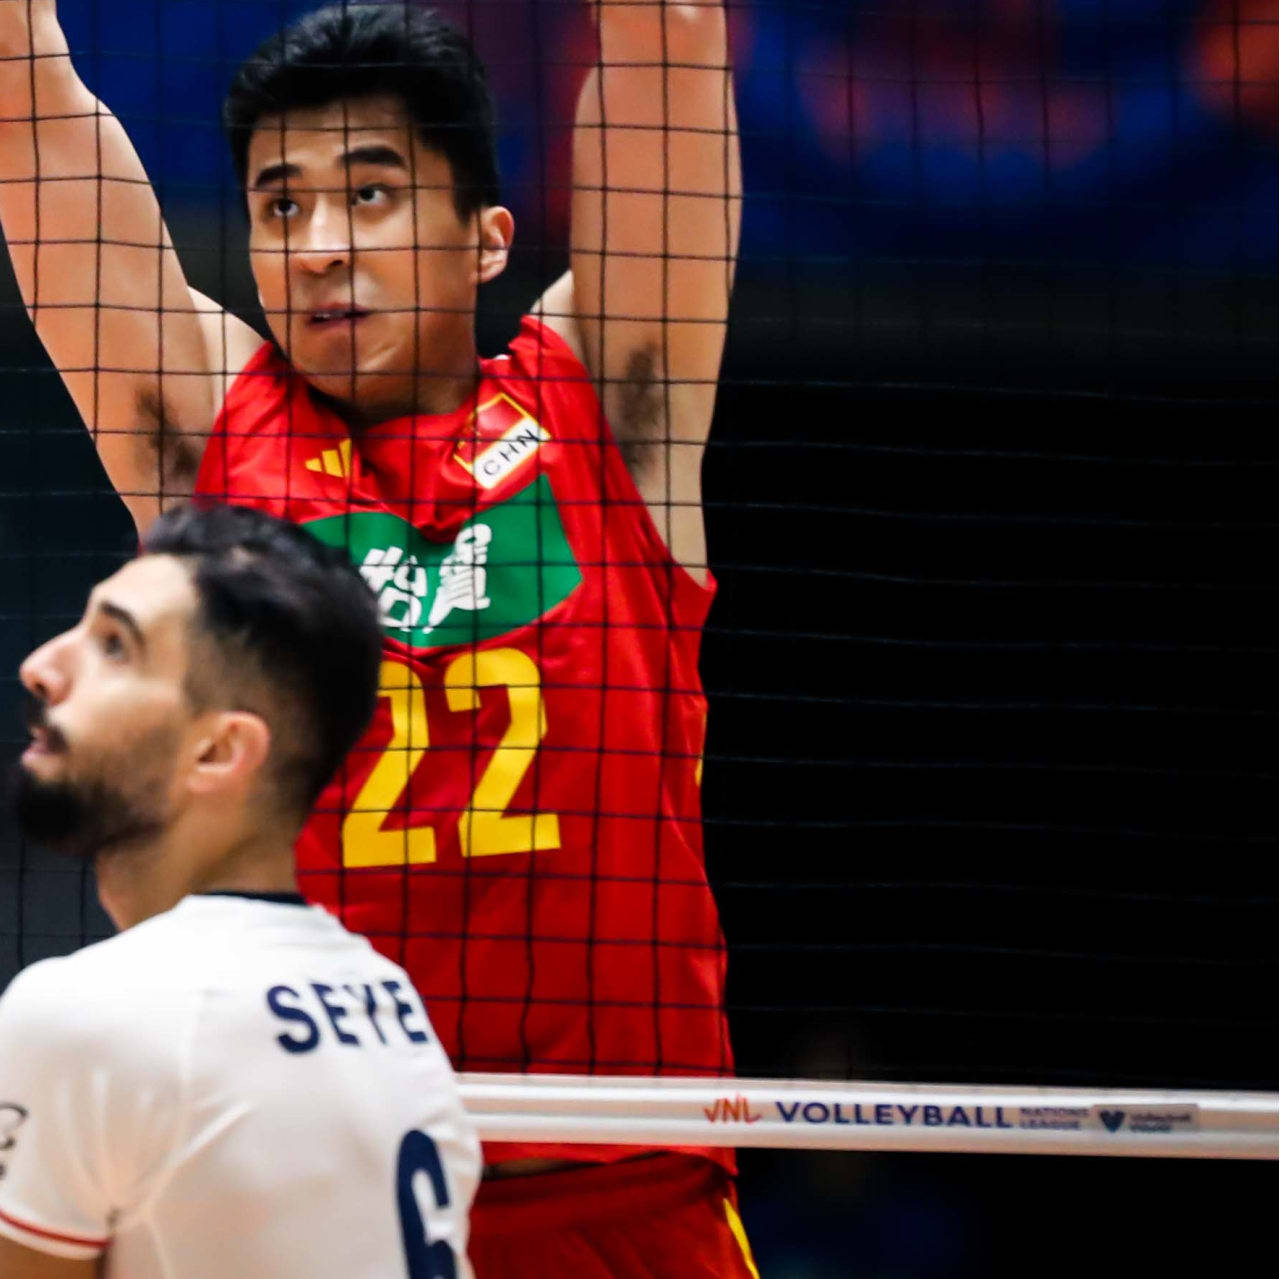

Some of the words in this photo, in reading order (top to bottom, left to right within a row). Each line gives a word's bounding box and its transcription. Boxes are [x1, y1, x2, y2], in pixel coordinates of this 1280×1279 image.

[482, 425, 540, 478] CHN
[341, 646, 562, 868] 22
[266, 978, 430, 1055] SEYE
[703, 1091, 763, 1125] VNL
[775, 1101, 1013, 1128] VOLLEYBALL
